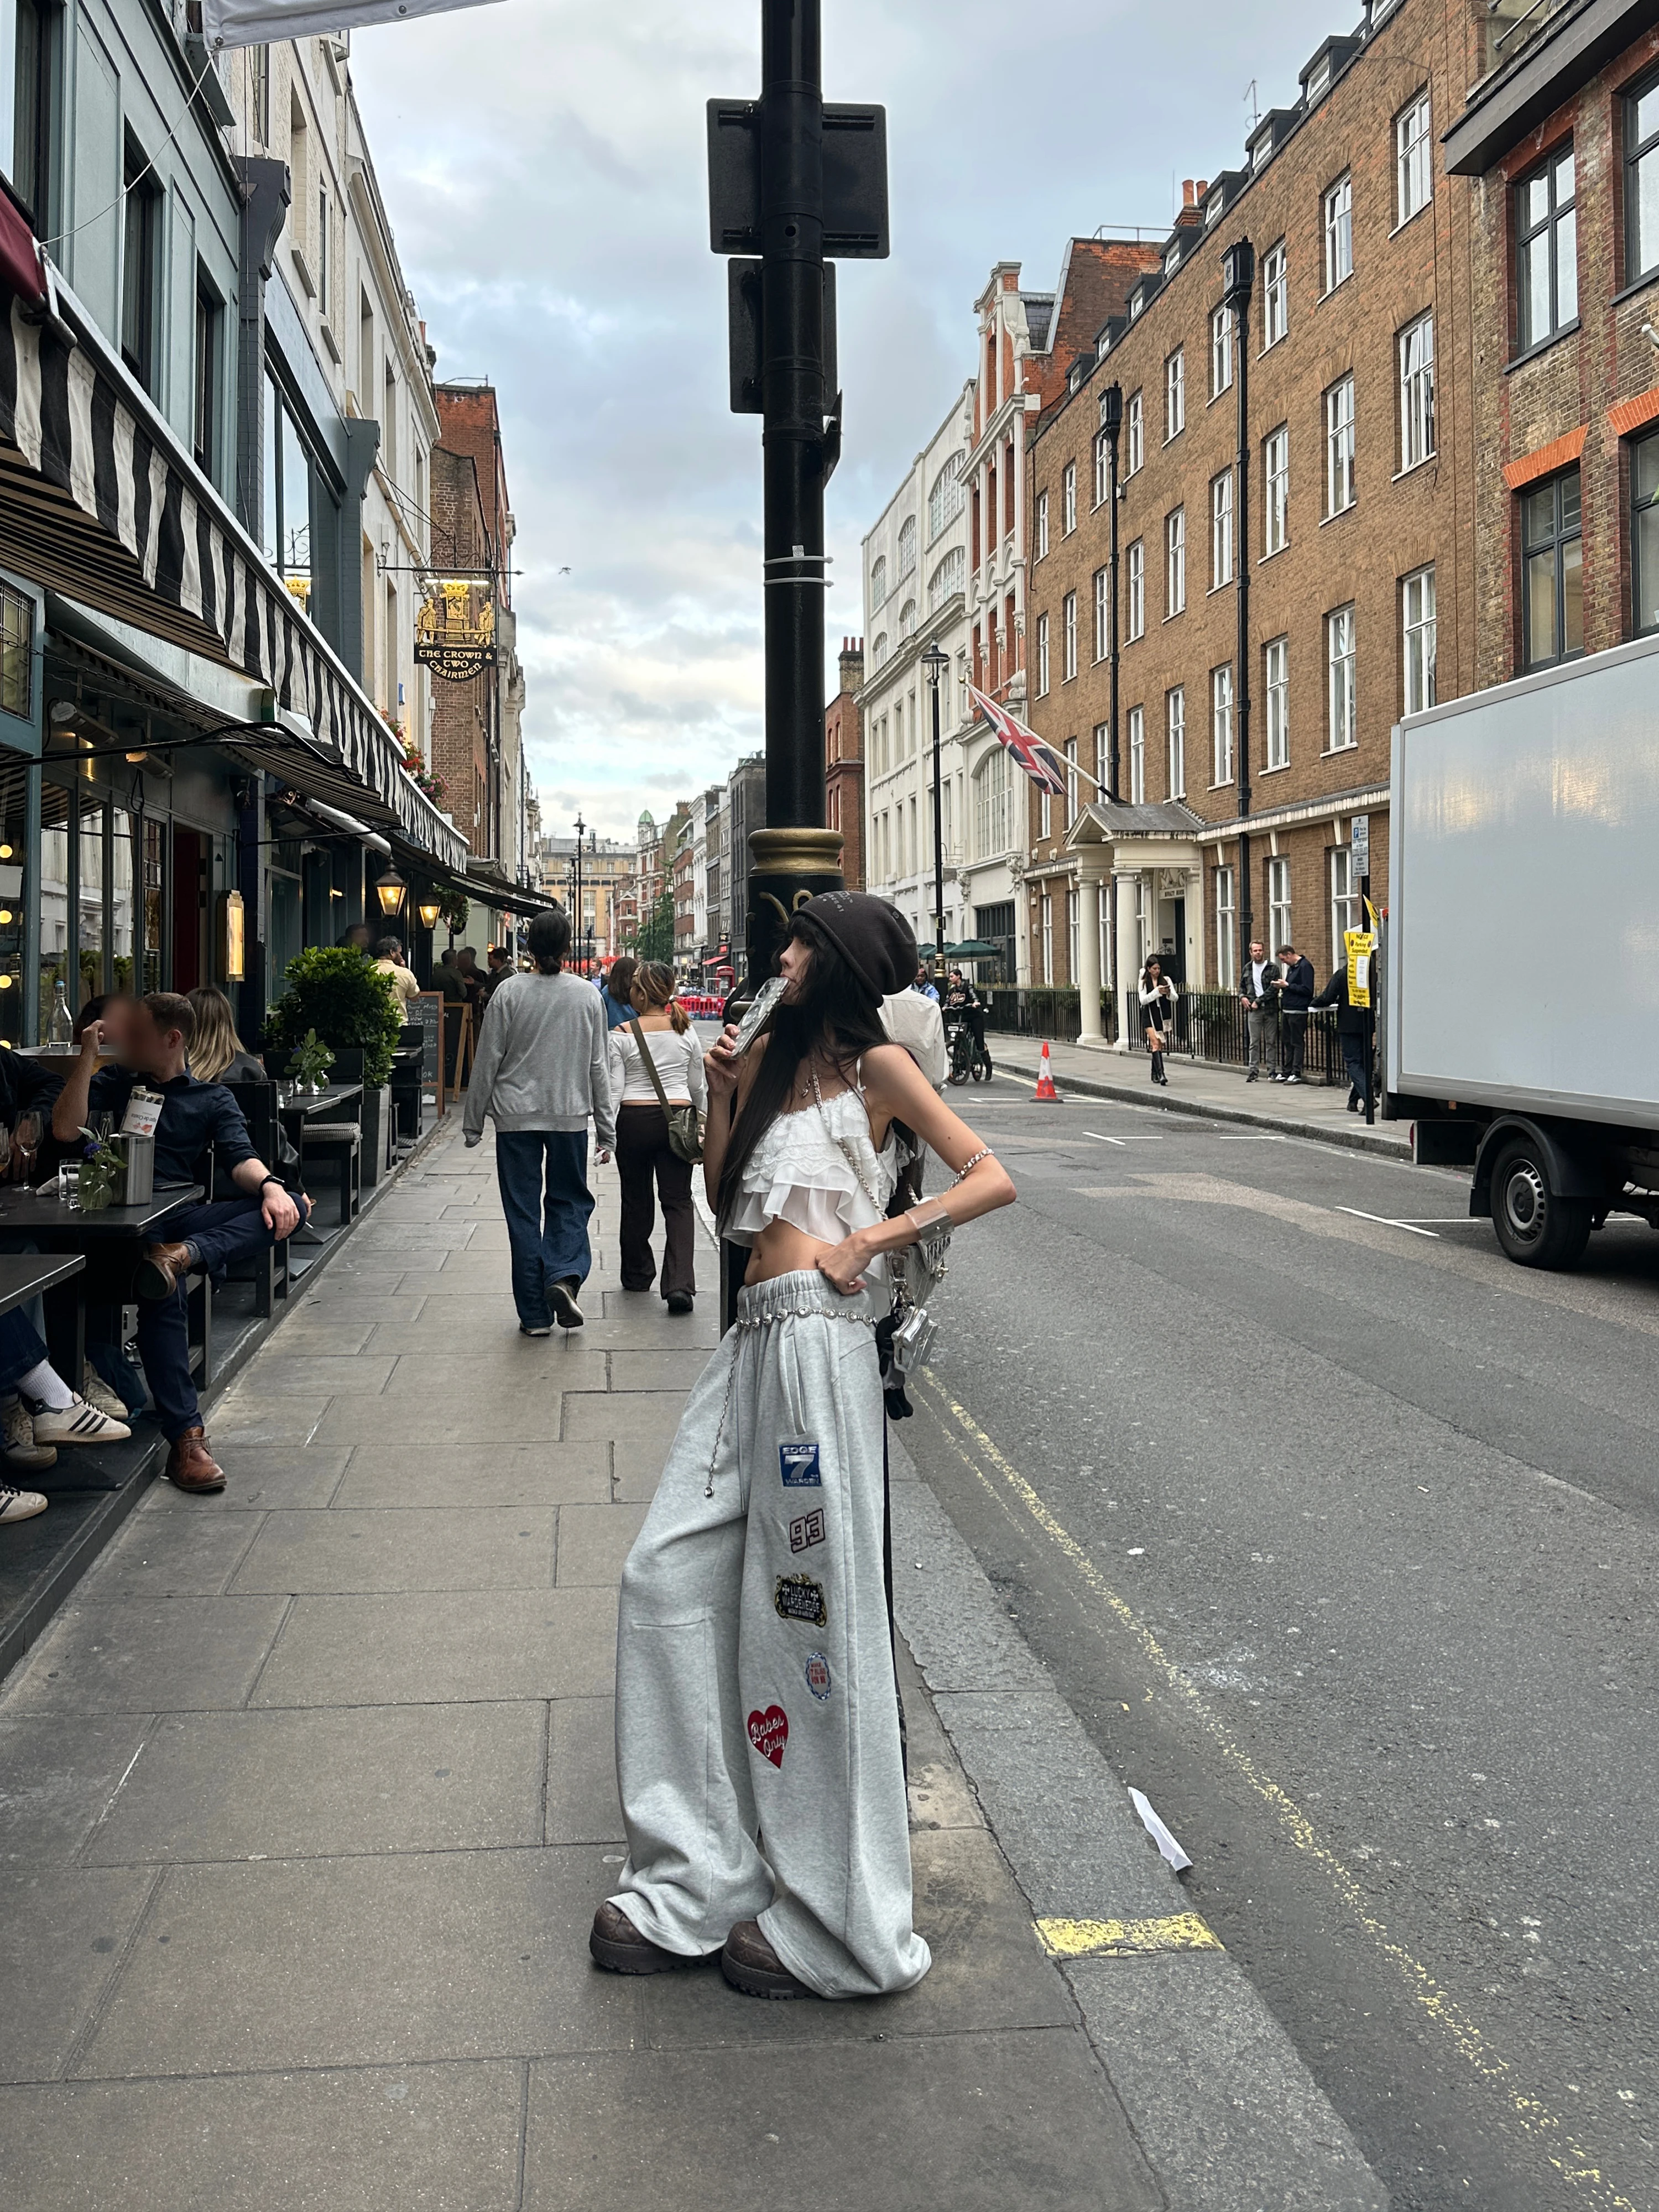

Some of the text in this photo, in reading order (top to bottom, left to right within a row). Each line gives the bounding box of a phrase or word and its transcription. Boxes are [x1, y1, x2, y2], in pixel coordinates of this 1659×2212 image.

[419, 650, 441, 658] THE
[443, 650, 482, 659] CROWN
[443, 659, 469, 668] TWO
[429, 660, 482, 679] CHAIRMEN
[782, 1446, 817, 1454] EDGE
[784, 1454, 815, 1478] 7
[789, 1508, 826, 1553] 93
[790, 1585, 810, 1599] LUCKY
[750, 1714, 785, 1744] Babes
[763, 1733, 786, 1758] Only
